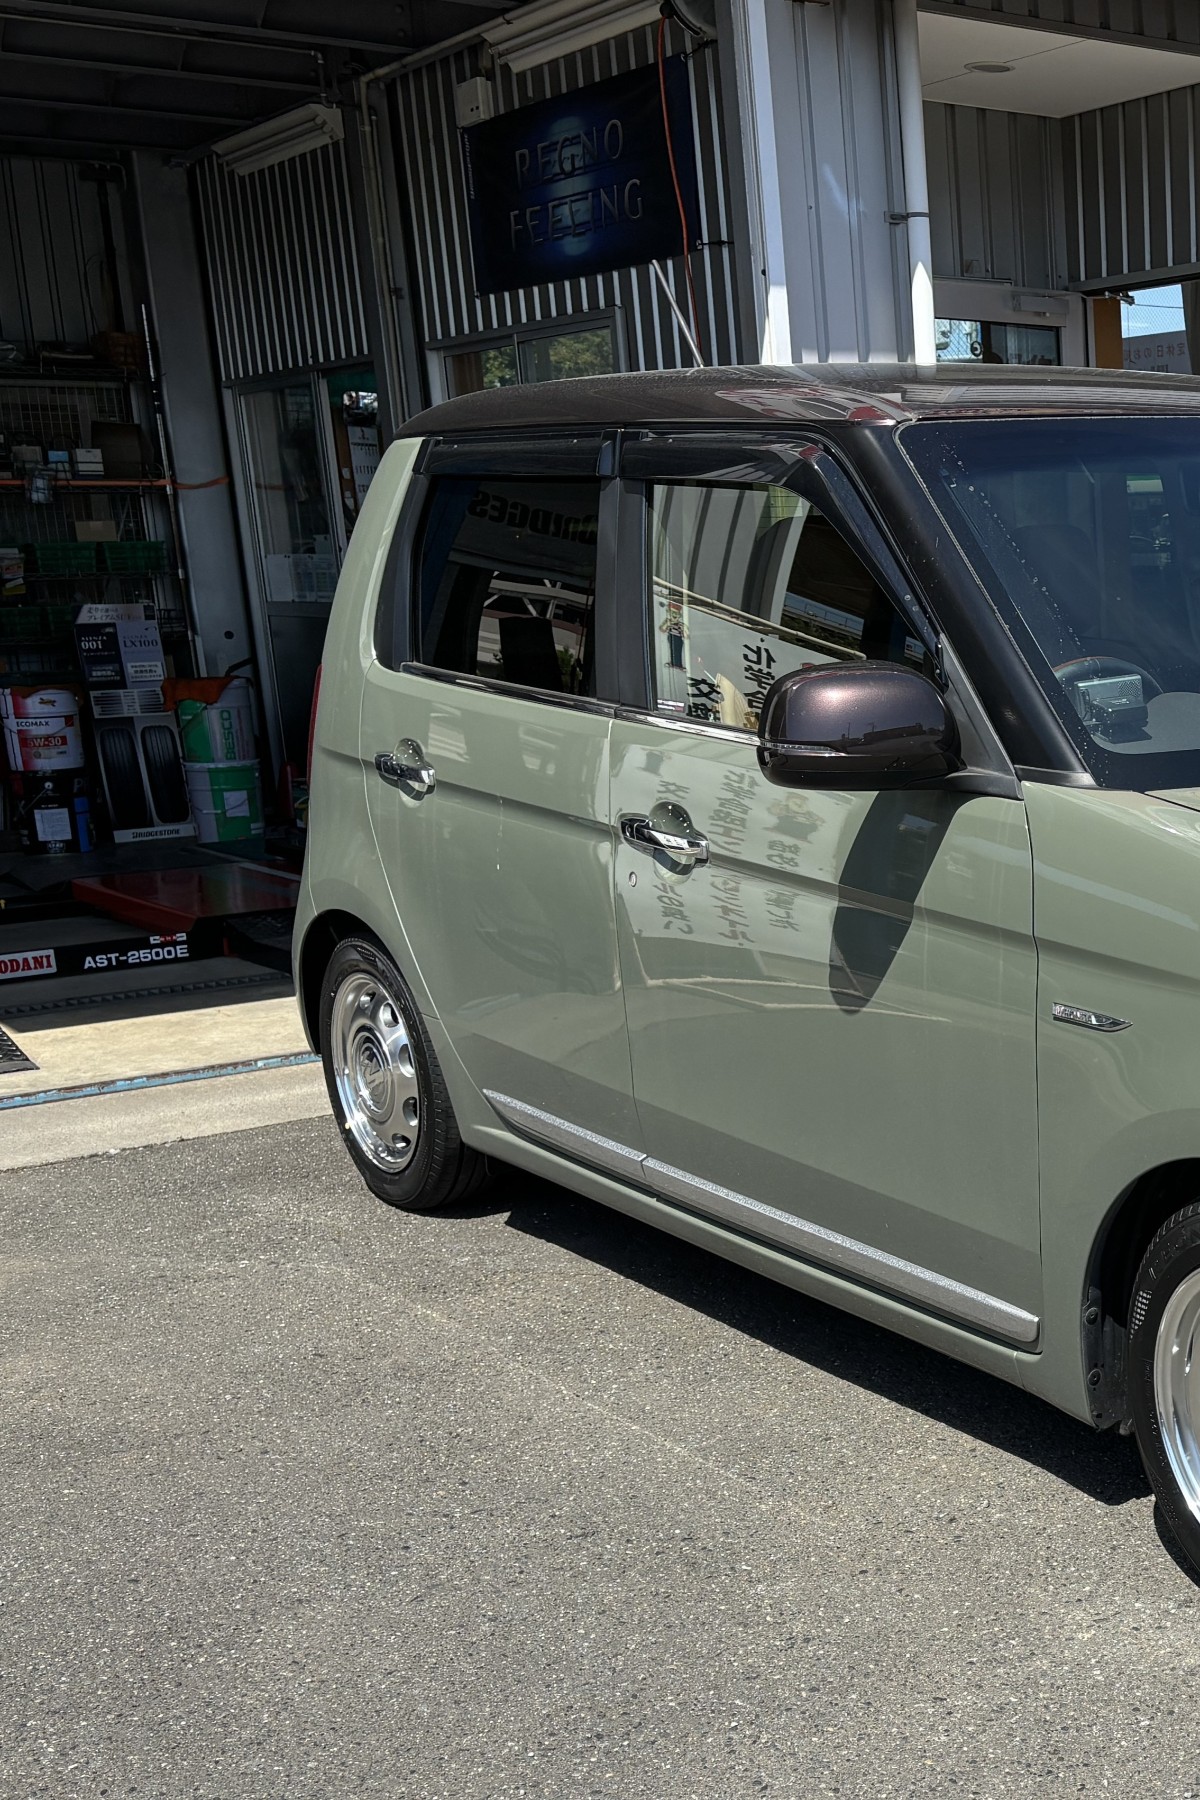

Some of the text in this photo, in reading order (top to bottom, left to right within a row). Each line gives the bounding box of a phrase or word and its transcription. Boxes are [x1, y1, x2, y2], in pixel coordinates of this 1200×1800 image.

[515, 119, 624, 190] REGNO
[509, 178, 644, 249] FEELING
[81, 640, 103, 650] 001
[123, 638, 159, 649] LX100
[16, 719, 51, 728] ECOMAX
[221, 709, 237, 761] BESCO
[131, 828, 181, 839] BRIDGESTONE
[83, 944, 190, 970] AST-2500E
